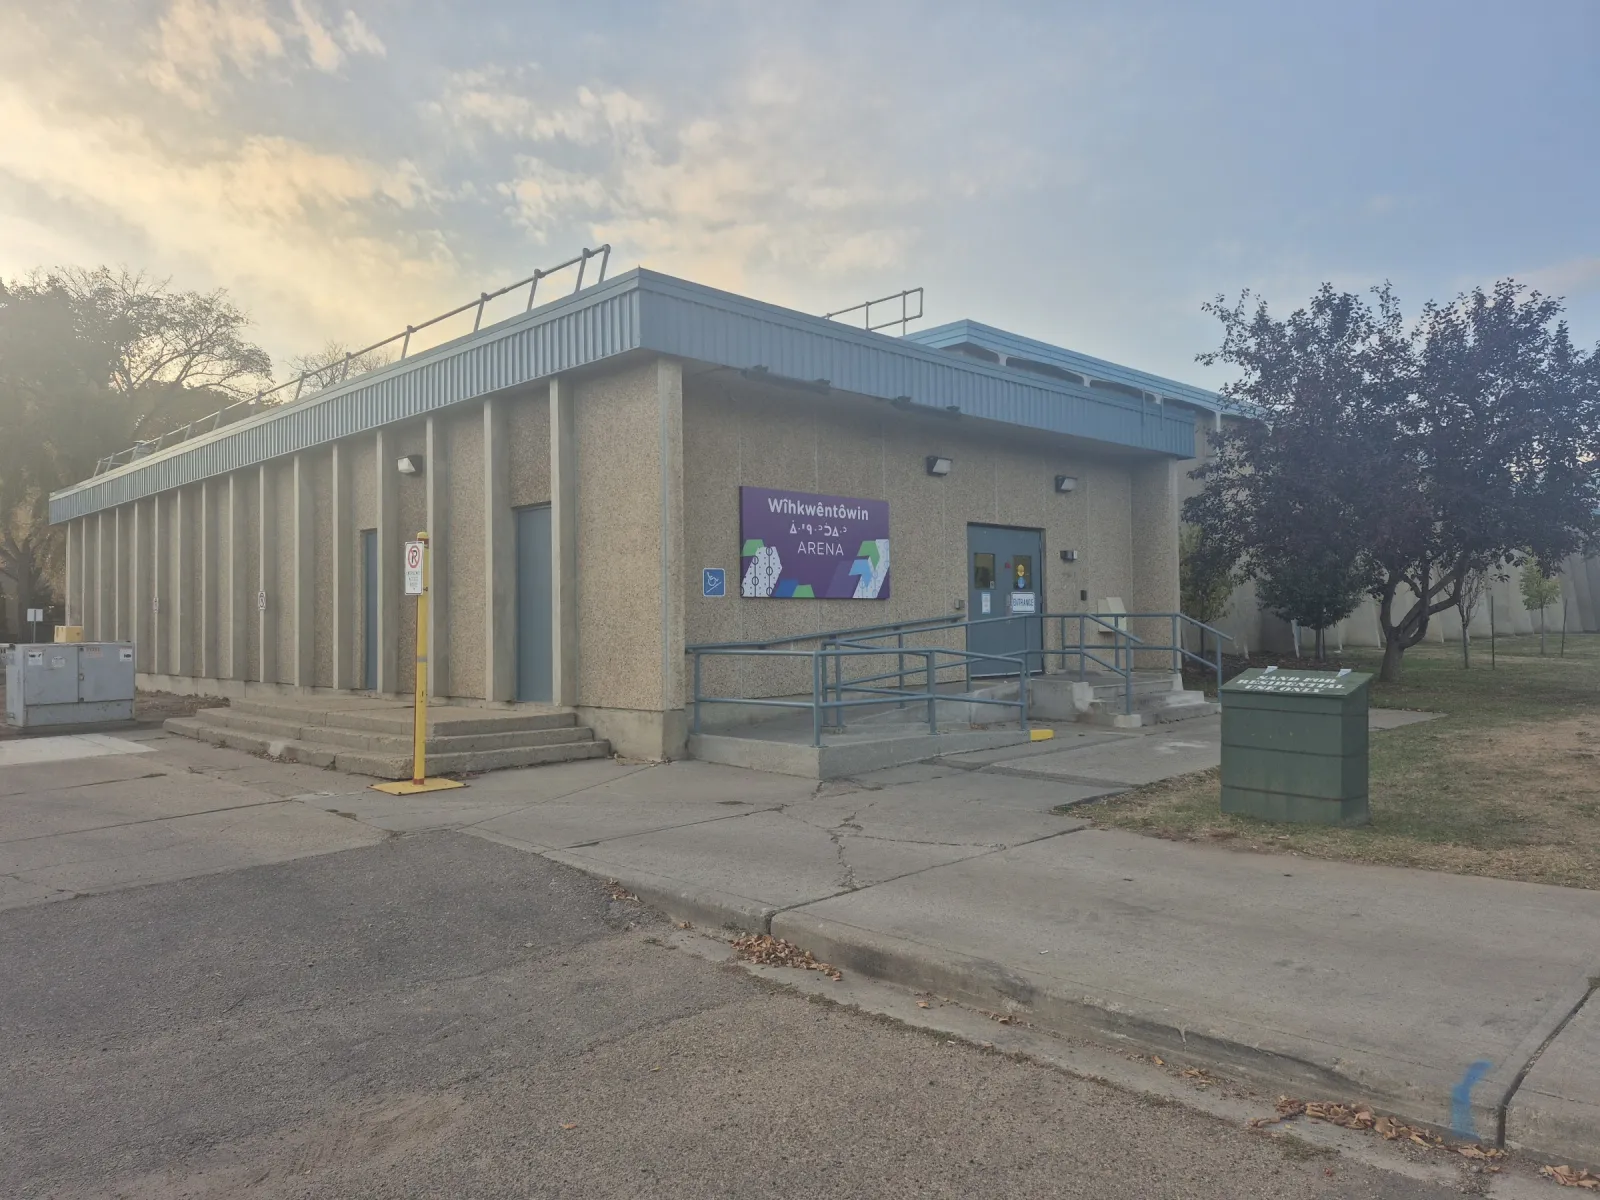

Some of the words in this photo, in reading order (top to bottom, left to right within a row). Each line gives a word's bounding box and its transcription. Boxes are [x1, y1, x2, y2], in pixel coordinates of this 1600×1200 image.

[768, 497, 869, 520] Wîhkwêntôwin
[797, 541, 844, 556] ARENA
[1012, 598, 1034, 607] ENTRANCE
[1236, 679, 1345, 689] RESIDENTIAL
[1245, 684, 1277, 692] USE
